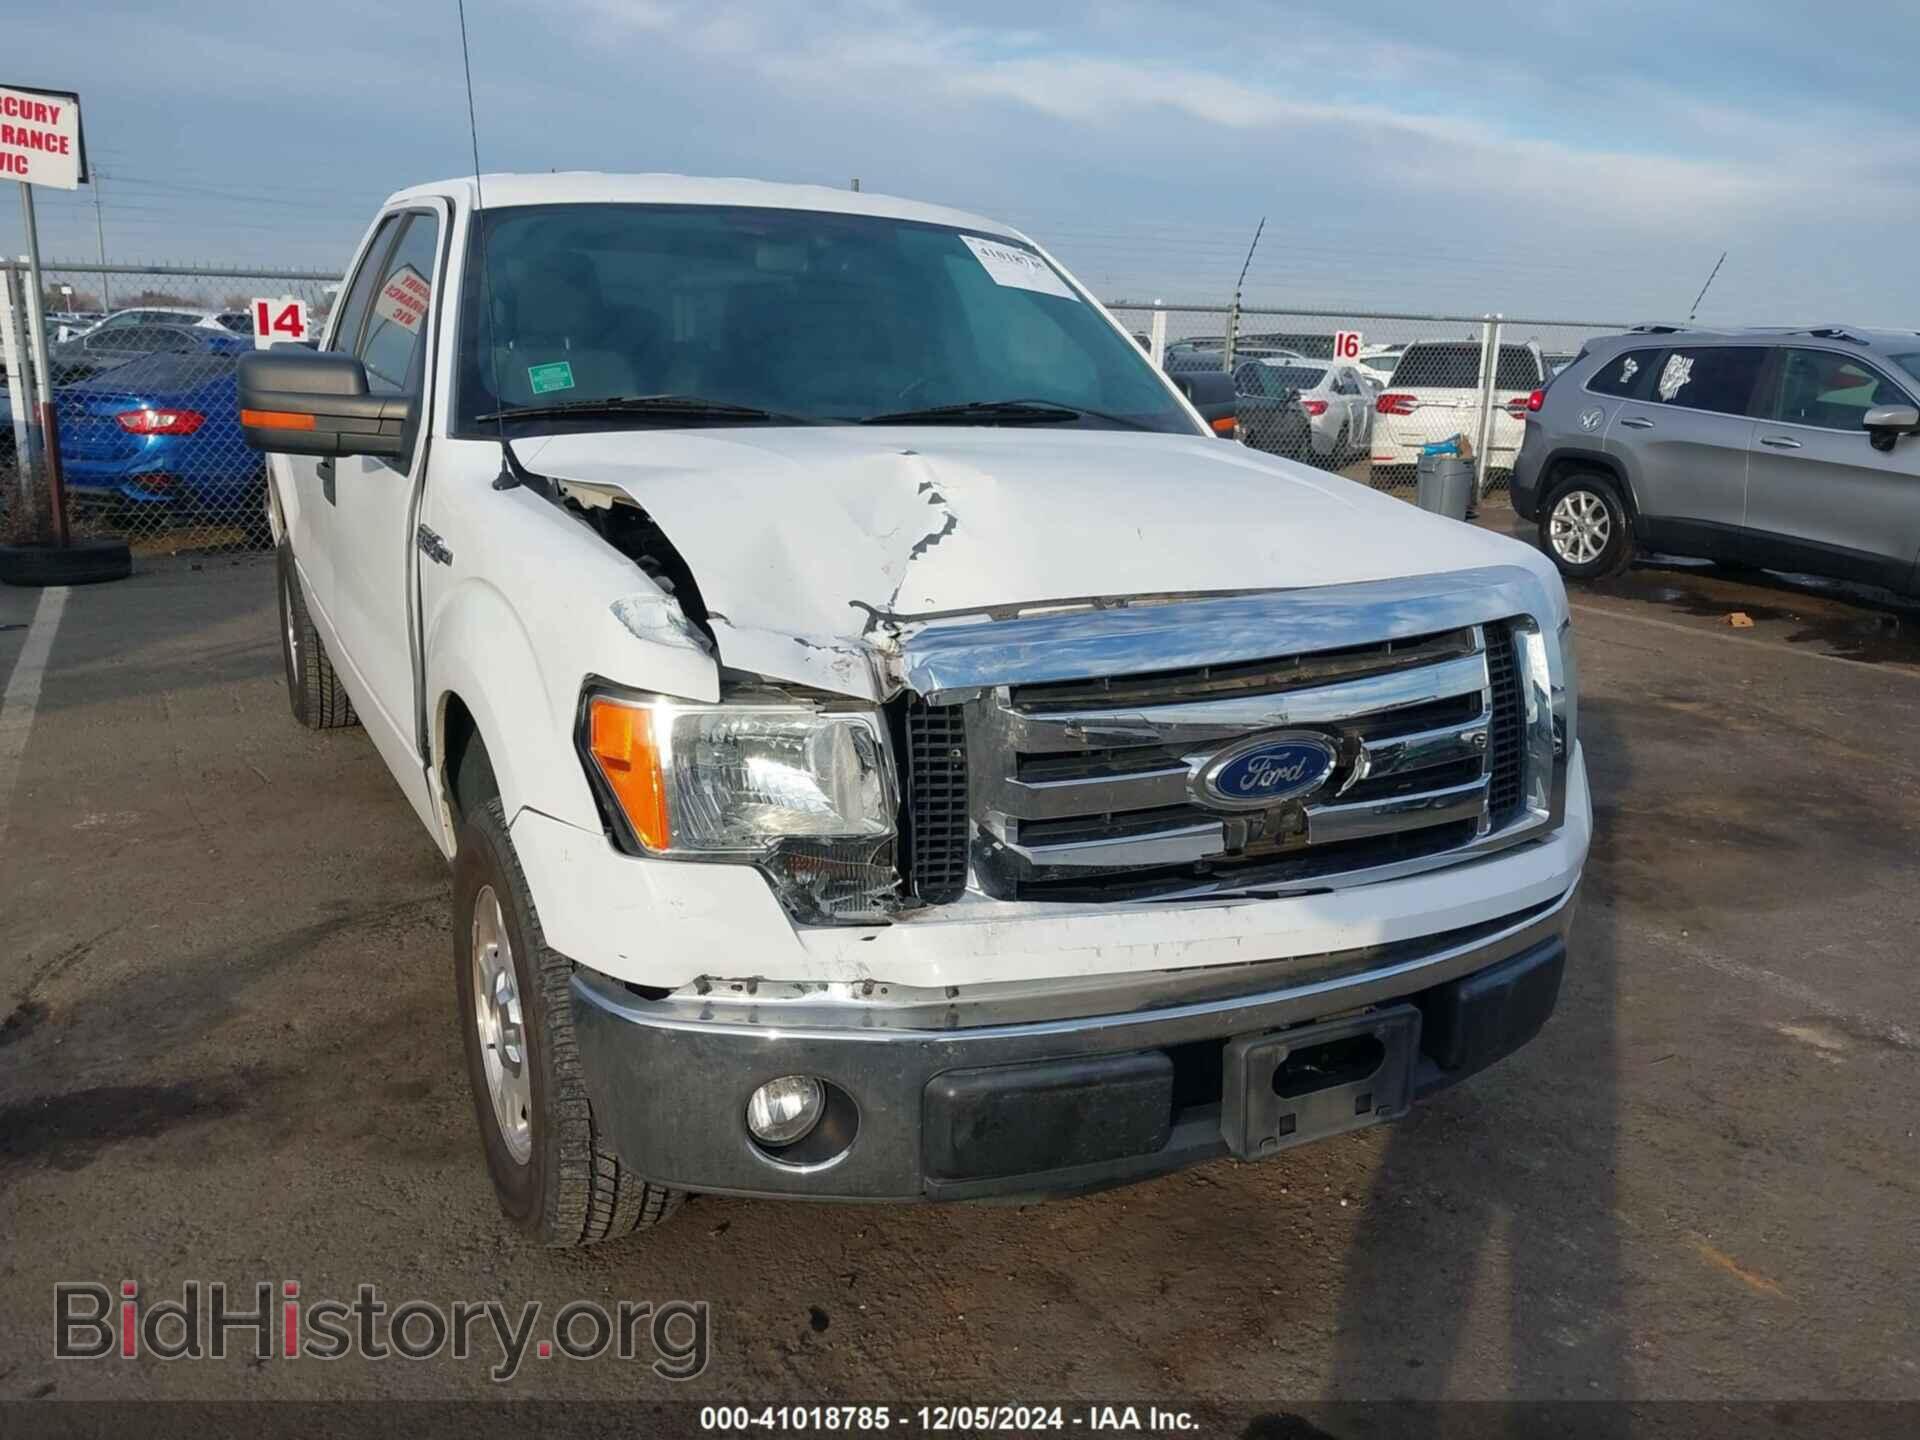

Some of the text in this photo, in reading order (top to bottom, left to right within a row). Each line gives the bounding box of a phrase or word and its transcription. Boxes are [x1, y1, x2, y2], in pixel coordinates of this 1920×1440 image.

[0, 96, 61, 126] CURY
[1, 123, 70, 155] RANCE
[257, 302, 304, 338] 14
[1336, 332, 1359, 358] 16
[1239, 751, 1307, 791] Ford
